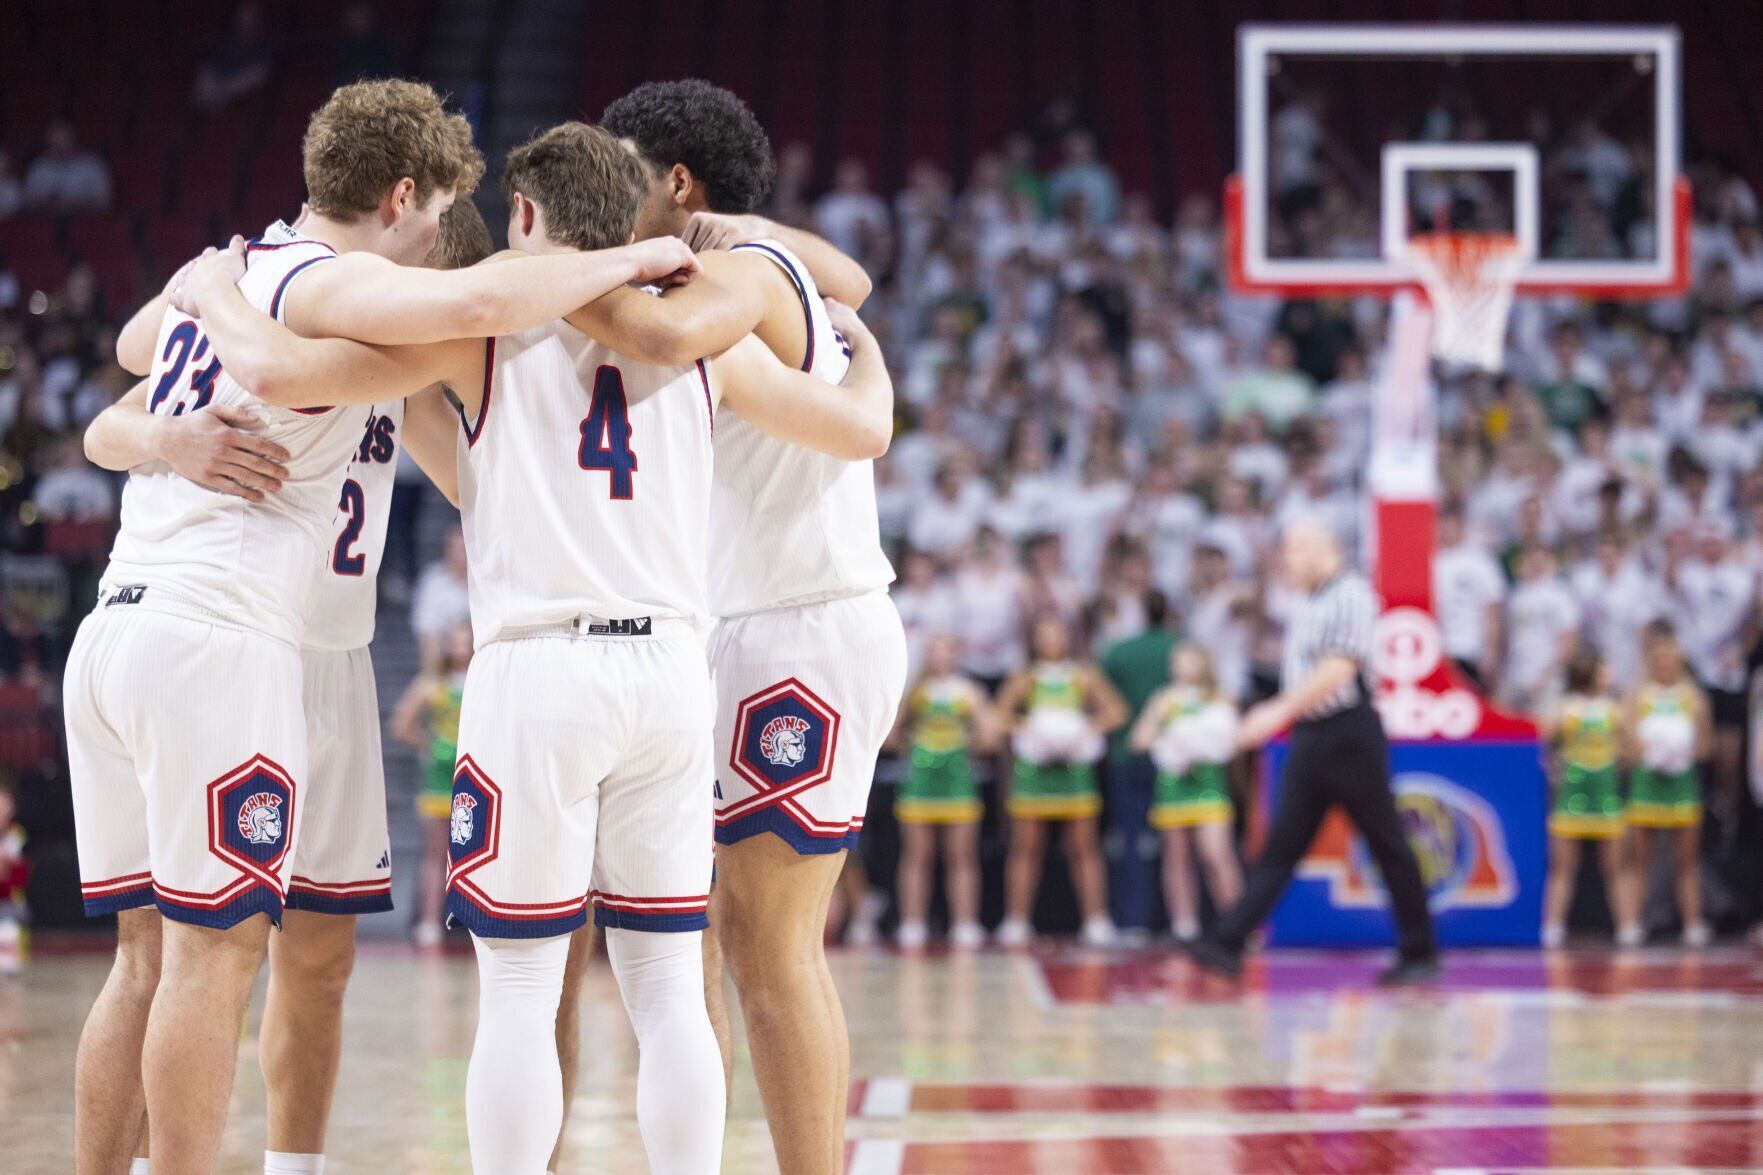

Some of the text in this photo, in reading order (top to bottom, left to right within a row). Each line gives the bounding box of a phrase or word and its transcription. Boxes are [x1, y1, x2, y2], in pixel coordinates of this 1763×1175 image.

[578, 365, 638, 500] 4
[760, 715, 811, 759] TITANS
[238, 791, 283, 839] TITANS
